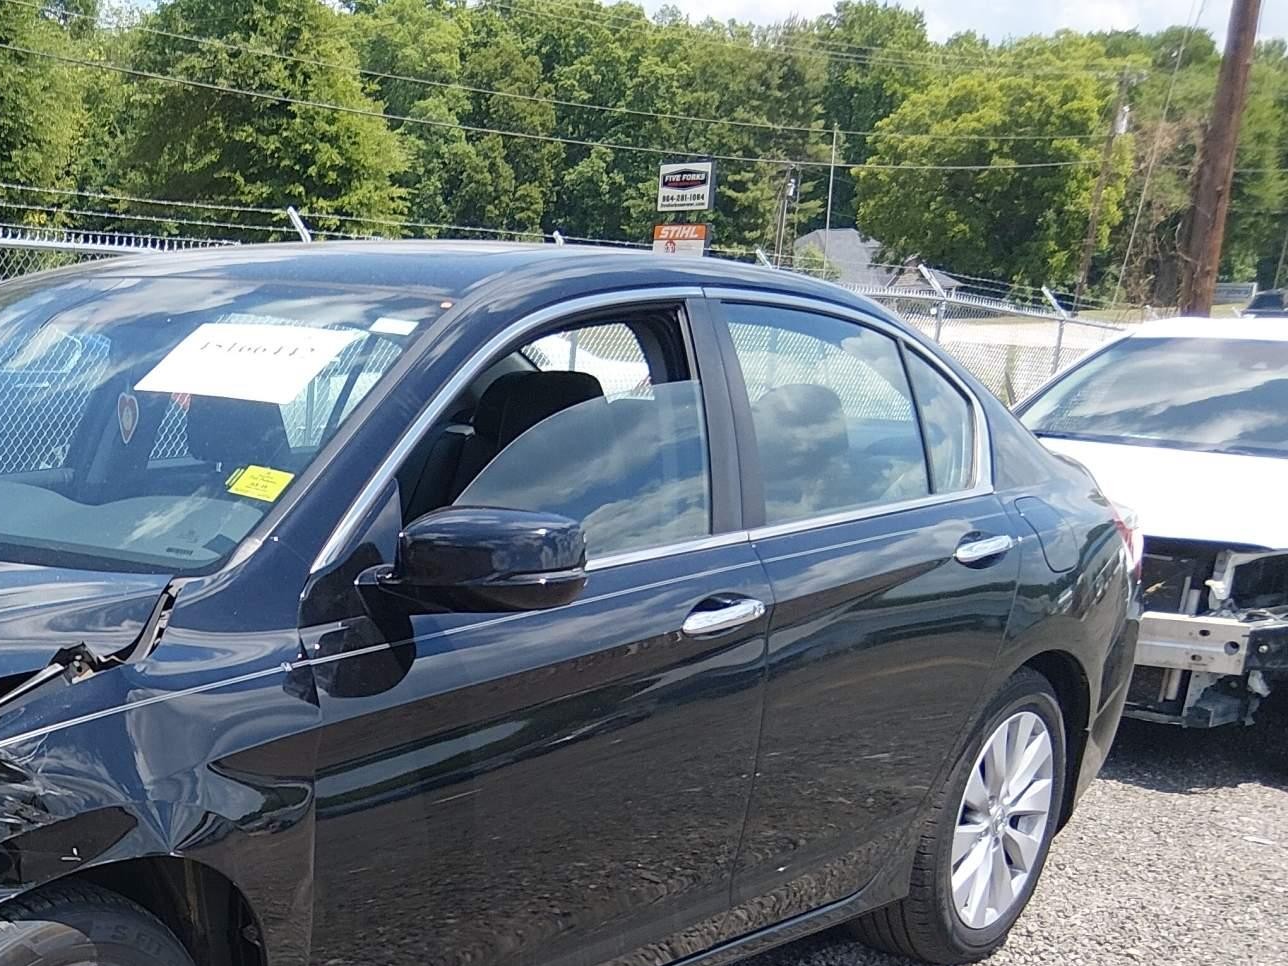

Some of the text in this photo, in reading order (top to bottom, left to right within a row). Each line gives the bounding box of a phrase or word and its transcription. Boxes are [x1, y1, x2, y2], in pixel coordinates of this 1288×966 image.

[665, 173, 705, 182] FIVE FORKS
[659, 226, 698, 238] STIHL
